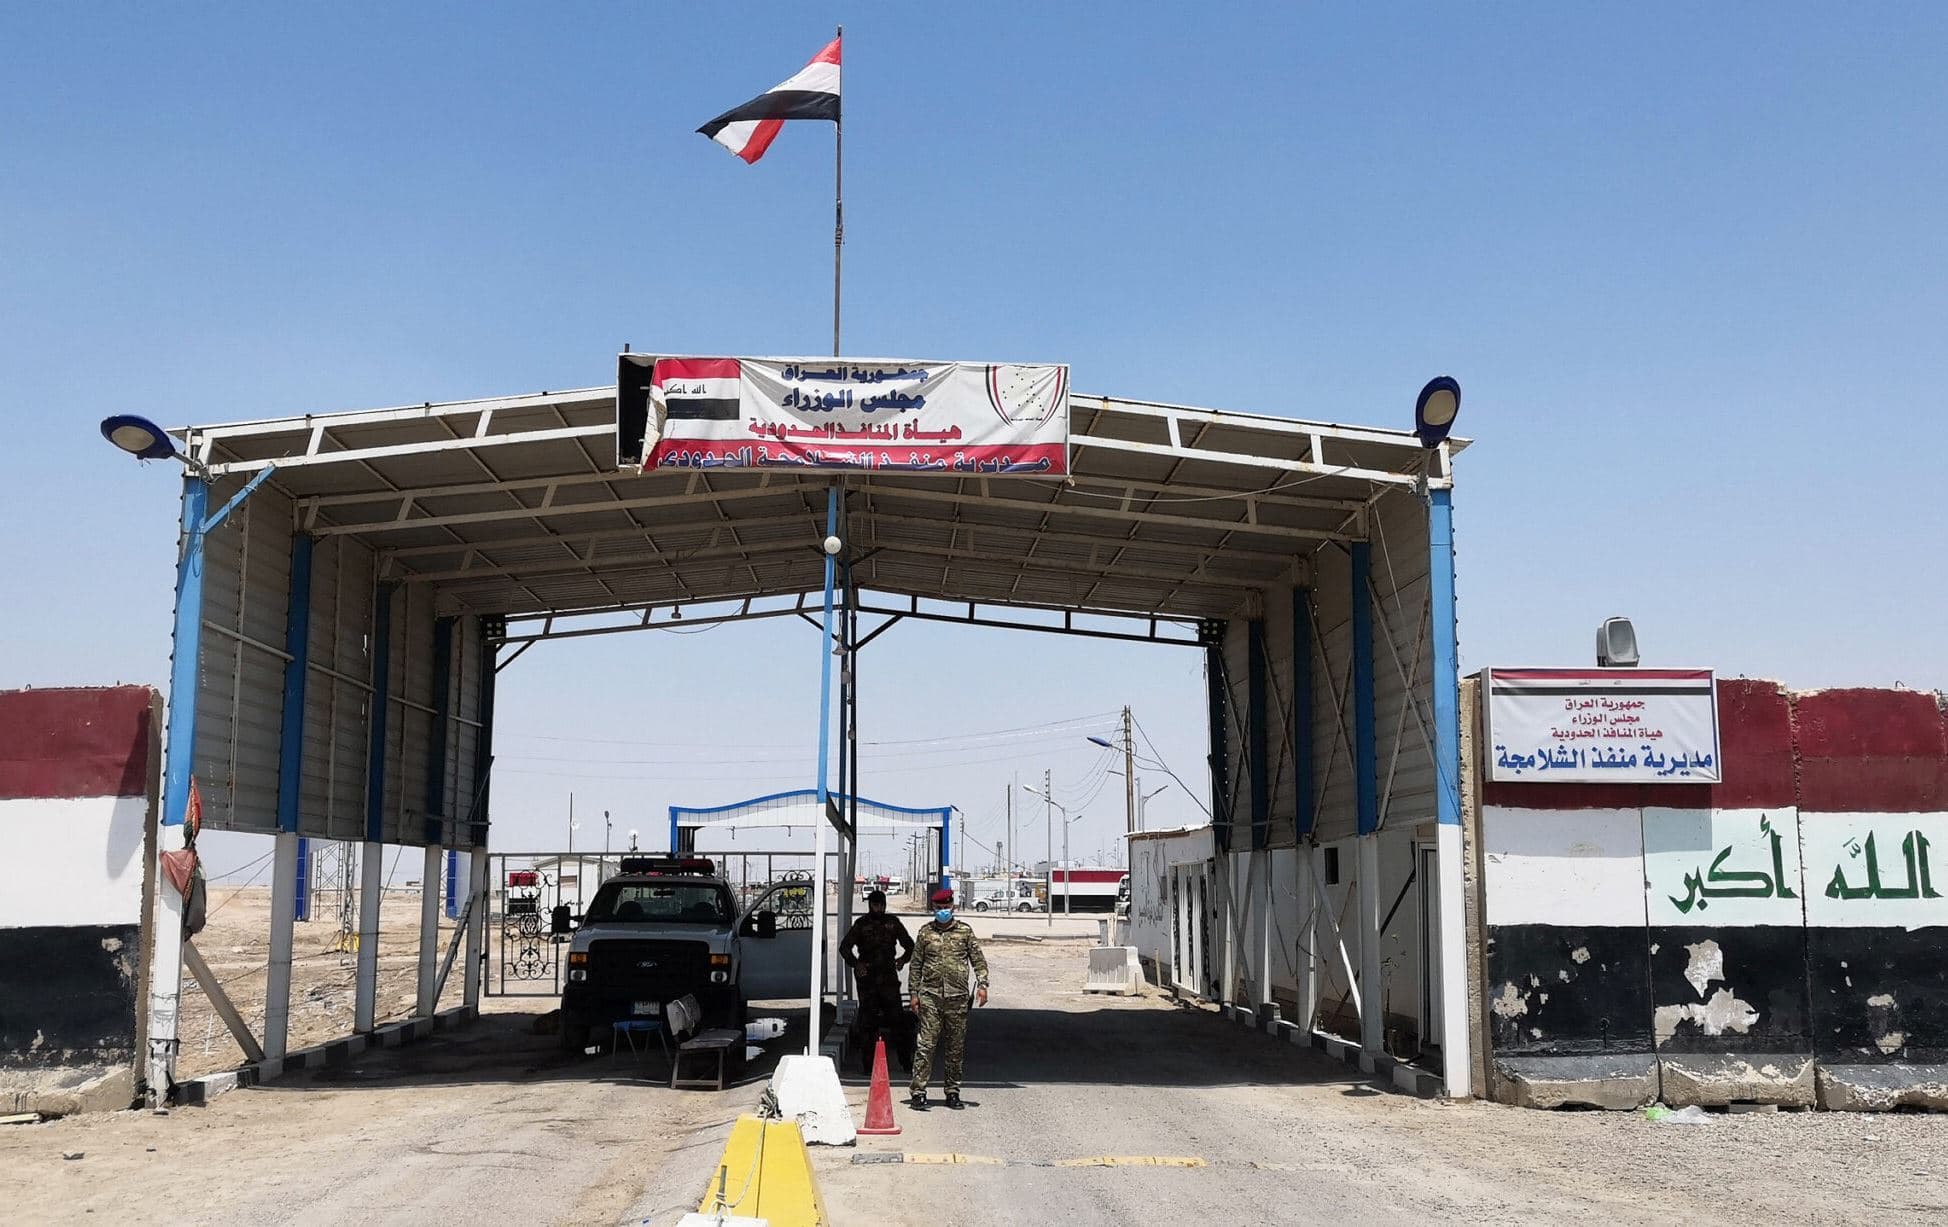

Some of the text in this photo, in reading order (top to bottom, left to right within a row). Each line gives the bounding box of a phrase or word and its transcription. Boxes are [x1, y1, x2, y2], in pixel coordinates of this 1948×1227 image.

[781, 364, 848, 382] العراق
[781, 387, 926, 413] مجلس الوزراء
[749, 417, 962, 444] هيأة المنافذ الحدودية
[878, 451, 948, 472] منفذ
[1564, 697, 1645, 711] جمهورية العراق
[1572, 713, 1640, 725] مجلس الوزراء
[1551, 727, 1600, 741] الحدودية
[1602, 727, 1636, 738] المنافذ
[1495, 744, 1713, 776] مديرية منفذ الشلامجة
[1667, 812, 1800, 914] أكبر
